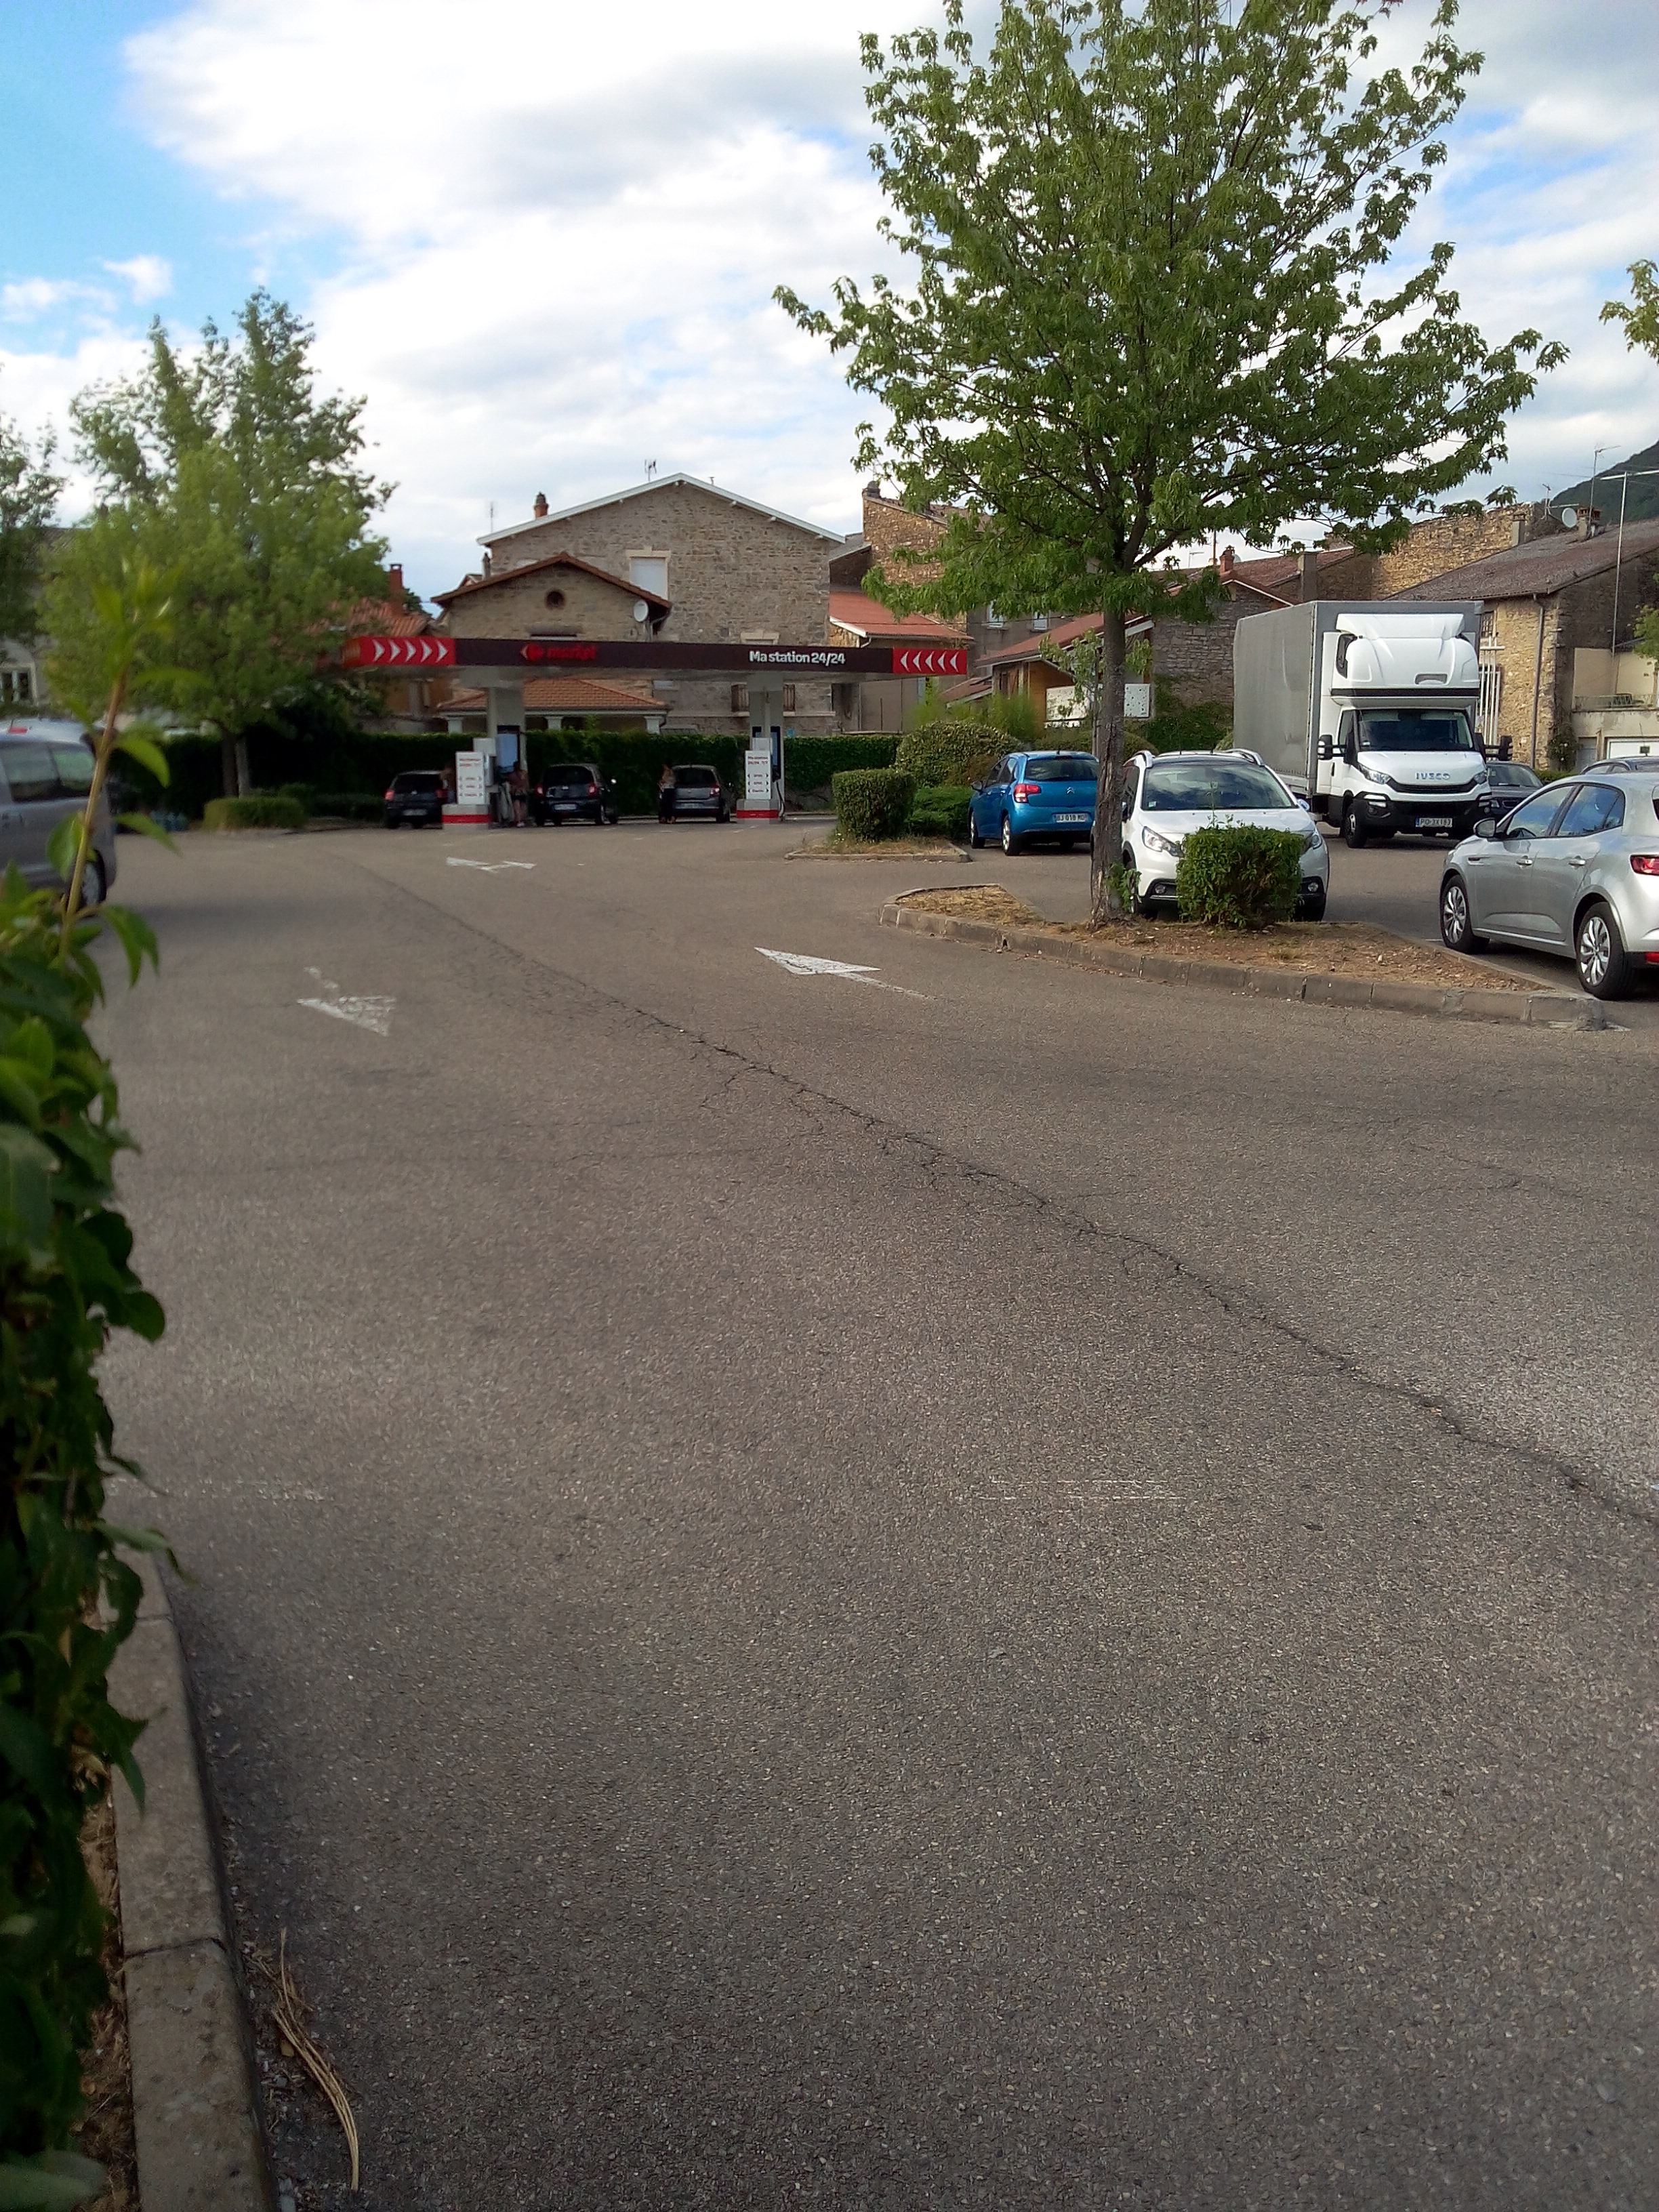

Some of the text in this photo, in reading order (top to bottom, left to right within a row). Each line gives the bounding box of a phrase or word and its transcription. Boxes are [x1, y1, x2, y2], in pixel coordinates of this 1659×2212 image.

[749, 651, 846, 666] Ma station 24/24
[1416, 772, 1451, 781] IVECO
